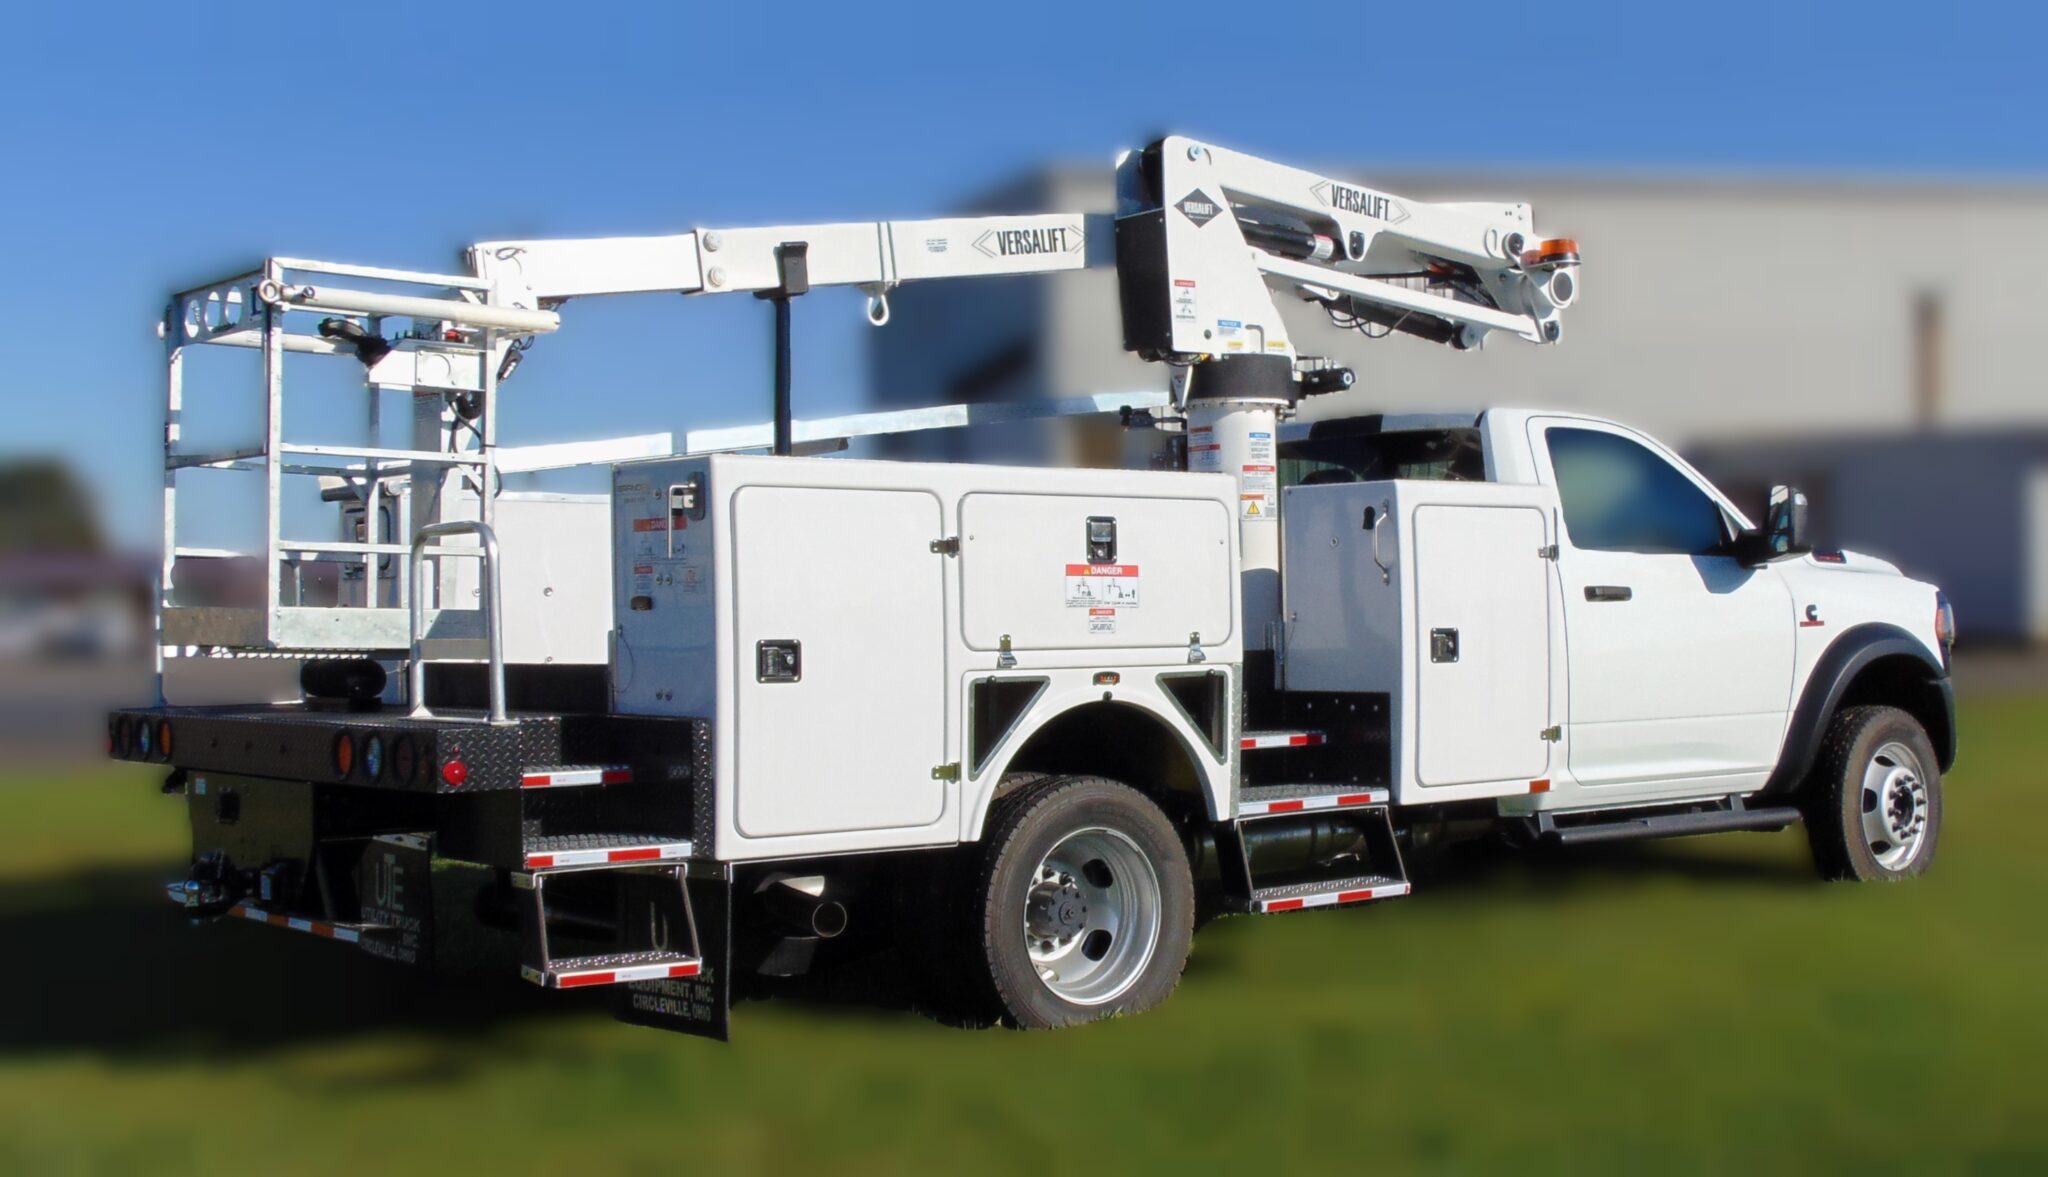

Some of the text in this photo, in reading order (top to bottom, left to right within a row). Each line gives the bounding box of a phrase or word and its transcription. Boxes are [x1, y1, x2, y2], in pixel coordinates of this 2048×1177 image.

[1331, 184, 1390, 221] VERSALIFT
[997, 228, 1066, 256] VERSALIFT
[1091, 566, 1123, 575] DANGER
[692, 1002, 711, 1022] OHIO
